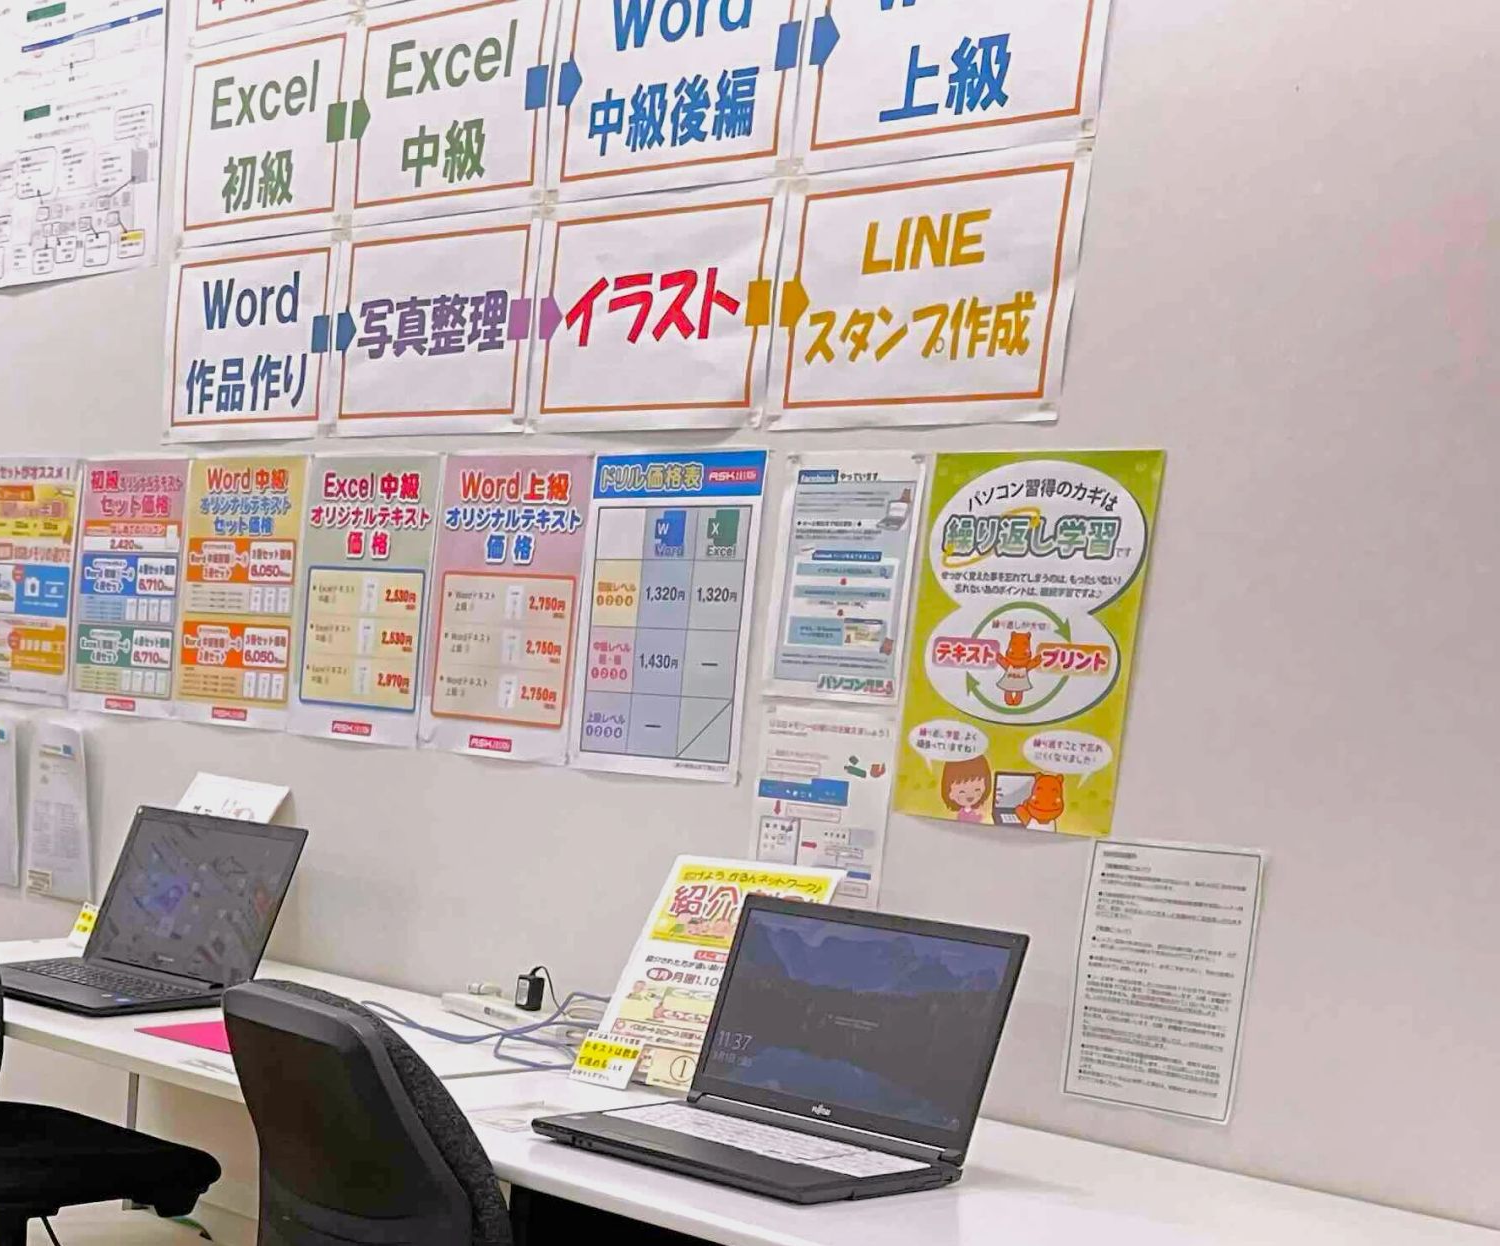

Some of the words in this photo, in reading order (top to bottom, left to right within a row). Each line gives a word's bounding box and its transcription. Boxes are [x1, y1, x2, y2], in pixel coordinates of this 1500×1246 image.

[386, 19, 518, 99] Excel
[879, 32, 1013, 123] 上級
[210, 59, 320, 130] Excel
[588, 67, 761, 156] 中級後編
[401, 118, 486, 188] 中級
[221, 149, 294, 214] 初級
[860, 208, 993, 275] LINE
[203, 270, 301, 331] Word
[564, 267, 741, 347] イラスト
[356, 289, 508, 359] 写真整理
[804, 291, 1037, 366] スタンプ作成
[186, 353, 308, 415] 作品作り
[207, 468, 251, 492] Word
[255, 470, 288, 491] 中級
[323, 472, 375, 499] Excel
[380, 472, 421, 500] 中級
[460, 471, 520, 502] Word
[523, 471, 570, 502] 上級
[600, 461, 704, 493] ドリル価格表
[100, 495, 171, 517] セット価格
[968, 479, 1119, 513] パソコン習得のカギは
[214, 518, 274, 536] セット価格
[311, 505, 431, 527] オリジナルテキスト
[445, 506, 581, 530] オリジナルテキスト
[645, 586, 686, 602] 1,320円
[696, 587, 738, 602] 1,320円
[639, 653, 679, 669] 1,430円
[936, 642, 995, 665] テキスト
[1041, 649, 1107, 672] プリント
